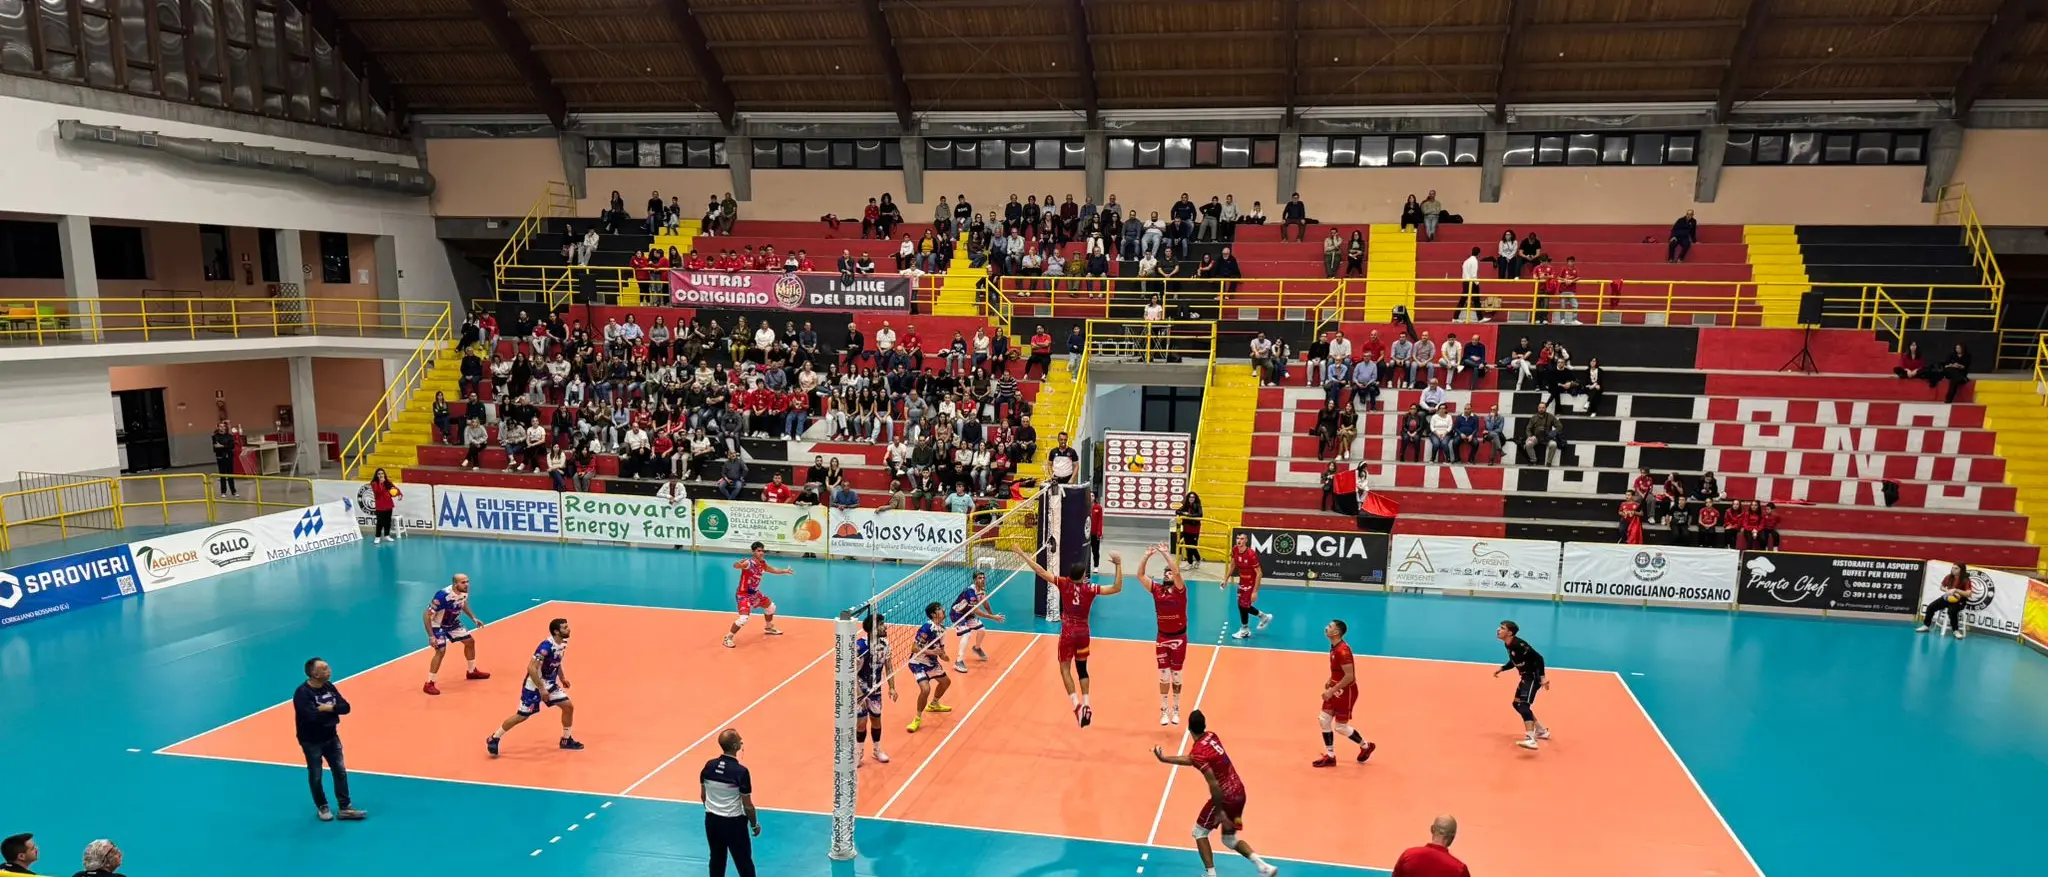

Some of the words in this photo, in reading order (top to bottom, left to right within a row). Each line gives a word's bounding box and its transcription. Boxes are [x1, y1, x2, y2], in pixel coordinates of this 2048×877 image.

[690, 274, 751, 288] ULTRAS
[830, 280, 835, 291] I
[675, 289, 769, 305] CORIGLIANO
[810, 293, 841, 306] DEL
[845, 294, 905, 307] BRILLIA
[475, 498, 558, 514] GIUSEPPE
[565, 495, 687, 519] Renovare
[477, 512, 559, 534] MIELE
[565, 516, 630, 540] Energy
[643, 520, 691, 539] Farm
[750, 518, 788, 526] CLEMENTINE
[210, 537, 249, 556] GALLO
[266, 549, 292, 561] Max
[294, 529, 358, 555] Automazioni
[1251, 532, 1368, 559] MORGIA
[152, 550, 199, 569] AGRICOR
[1832, 559, 1874, 568] RISTORANTE
[1876, 561, 1886, 569] DA
[1887, 562, 1919, 571] ASPORTO
[24, 555, 130, 594] SPROVIERI
[1842, 569, 1866, 577] BUFFET
[1868, 570, 1881, 578] PER
[1883, 571, 1907, 579] EVENTI
[1564, 580, 1593, 594] CITTÀ
[1595, 582, 1607, 595] DI
[1609, 583, 1731, 601] CORIGLIANO-ROSSANO
[1746, 574, 1789, 591] Pronto
[1794, 575, 1830, 597] Chef
[1072, 591, 1080, 606] 3
[1, 611, 35, 625] CORIGLIANO
[35, 605, 60, 617] ROSSANO
